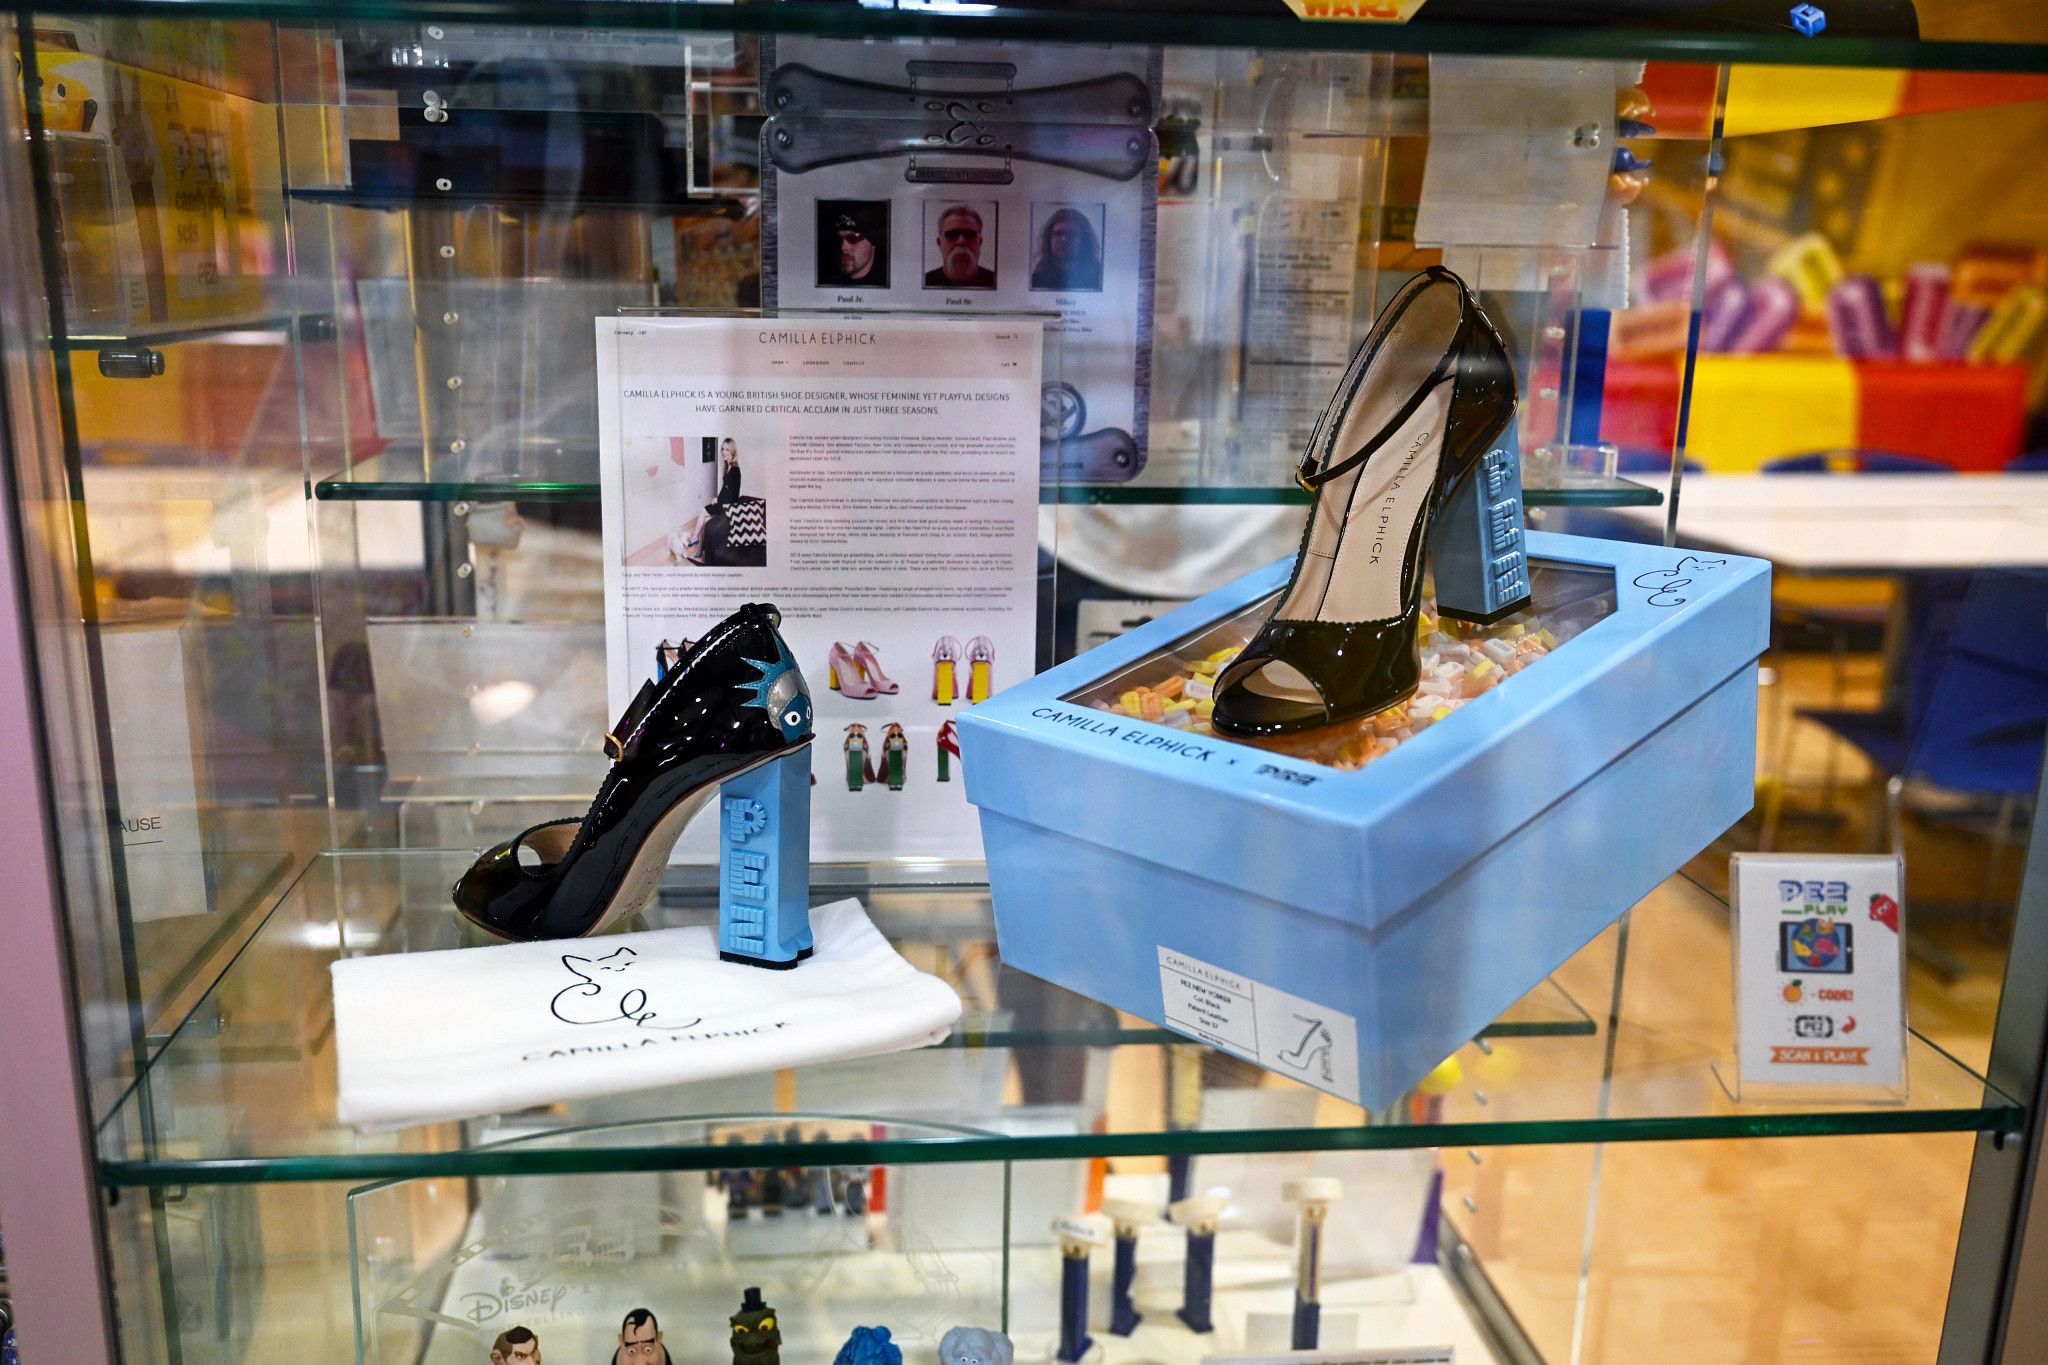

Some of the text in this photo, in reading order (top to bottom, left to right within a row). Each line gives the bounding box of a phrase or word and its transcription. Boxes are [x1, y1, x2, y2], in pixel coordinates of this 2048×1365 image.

[837, 295, 864, 304] Paul Jr.
[946, 297, 961, 305] Paul
[759, 332, 877, 345] CAMILLA ELPHICK
[624, 390, 1010, 401] CAMILLA ELPHICK IS A YOUNG BRITISH SHOE DESIGNER, WHOSE FEMININE YET PLAYFUL DESIGNS
[695, 404, 939, 415] HAVE GARNERED CRITICAL ACCLAIM IN JUST THREE SEASONS.
[1369, 432, 1430, 565] CAMILLA ELPHICK
[1482, 448, 1524, 604] PEZ
[1032, 707, 1118, 738] CAMILLA
[1121, 730, 1215, 763] ELPHICK
[1255, 763, 1320, 786] PEZ
[724, 796, 769, 955] PEZ
[1779, 880, 1850, 902] PEZ
[1804, 904, 1848, 915] PLAY
[1166, 956, 1241, 990] CAMILLA ELPHICK
[1180, 979, 1192, 989] PEZ
[1192, 982, 1206, 995] NEW
[1188, 1002, 1228, 1024] Patent Leather
[1205, 999, 1221, 1010] Black
[522, 1038, 657, 1061] CAMILLA
